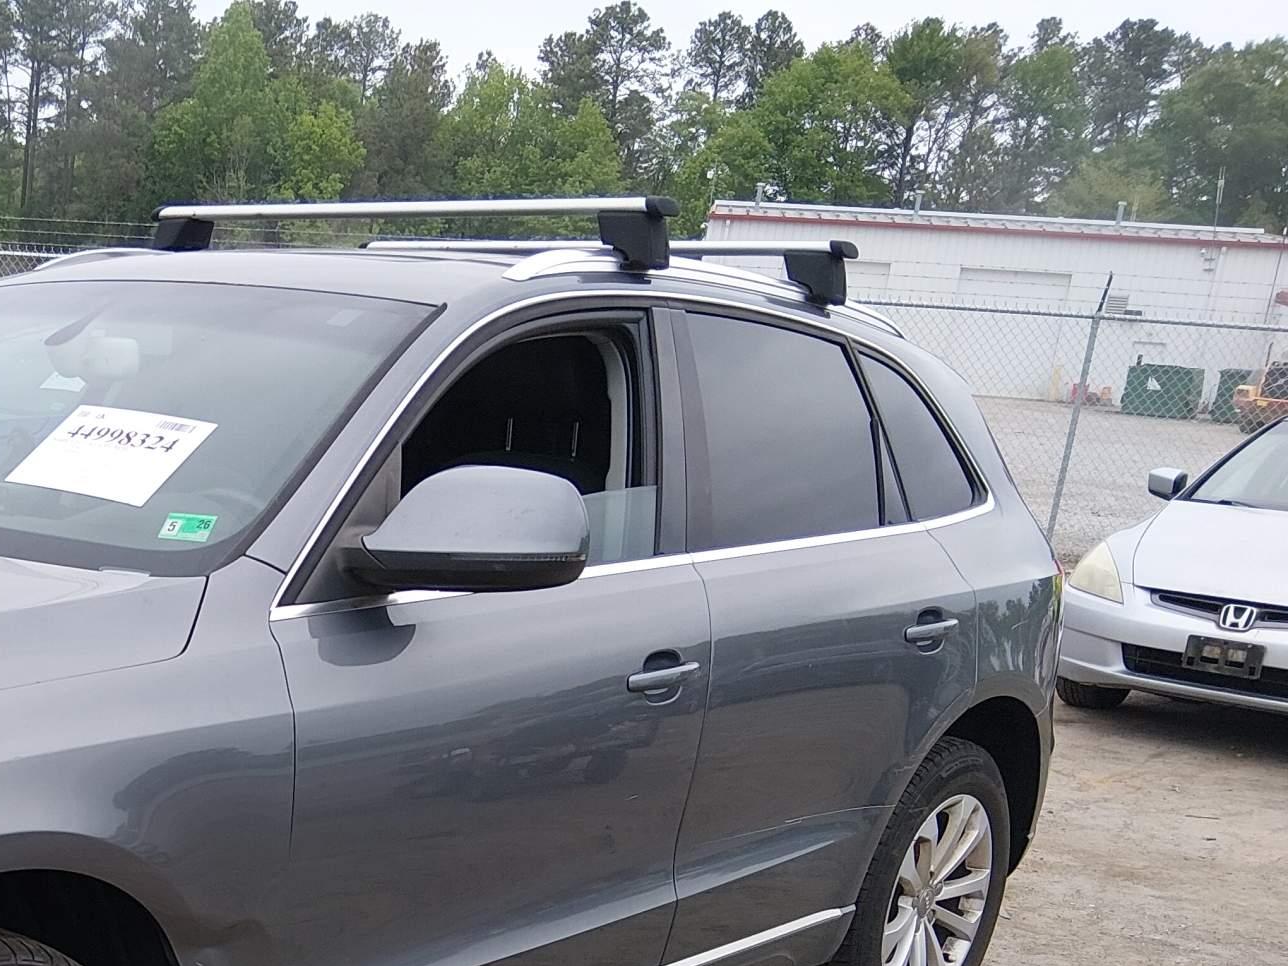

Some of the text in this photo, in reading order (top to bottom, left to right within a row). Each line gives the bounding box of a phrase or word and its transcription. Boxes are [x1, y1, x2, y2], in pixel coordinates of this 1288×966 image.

[68, 425, 179, 453] 44998324
[167, 519, 212, 532] 5 26
